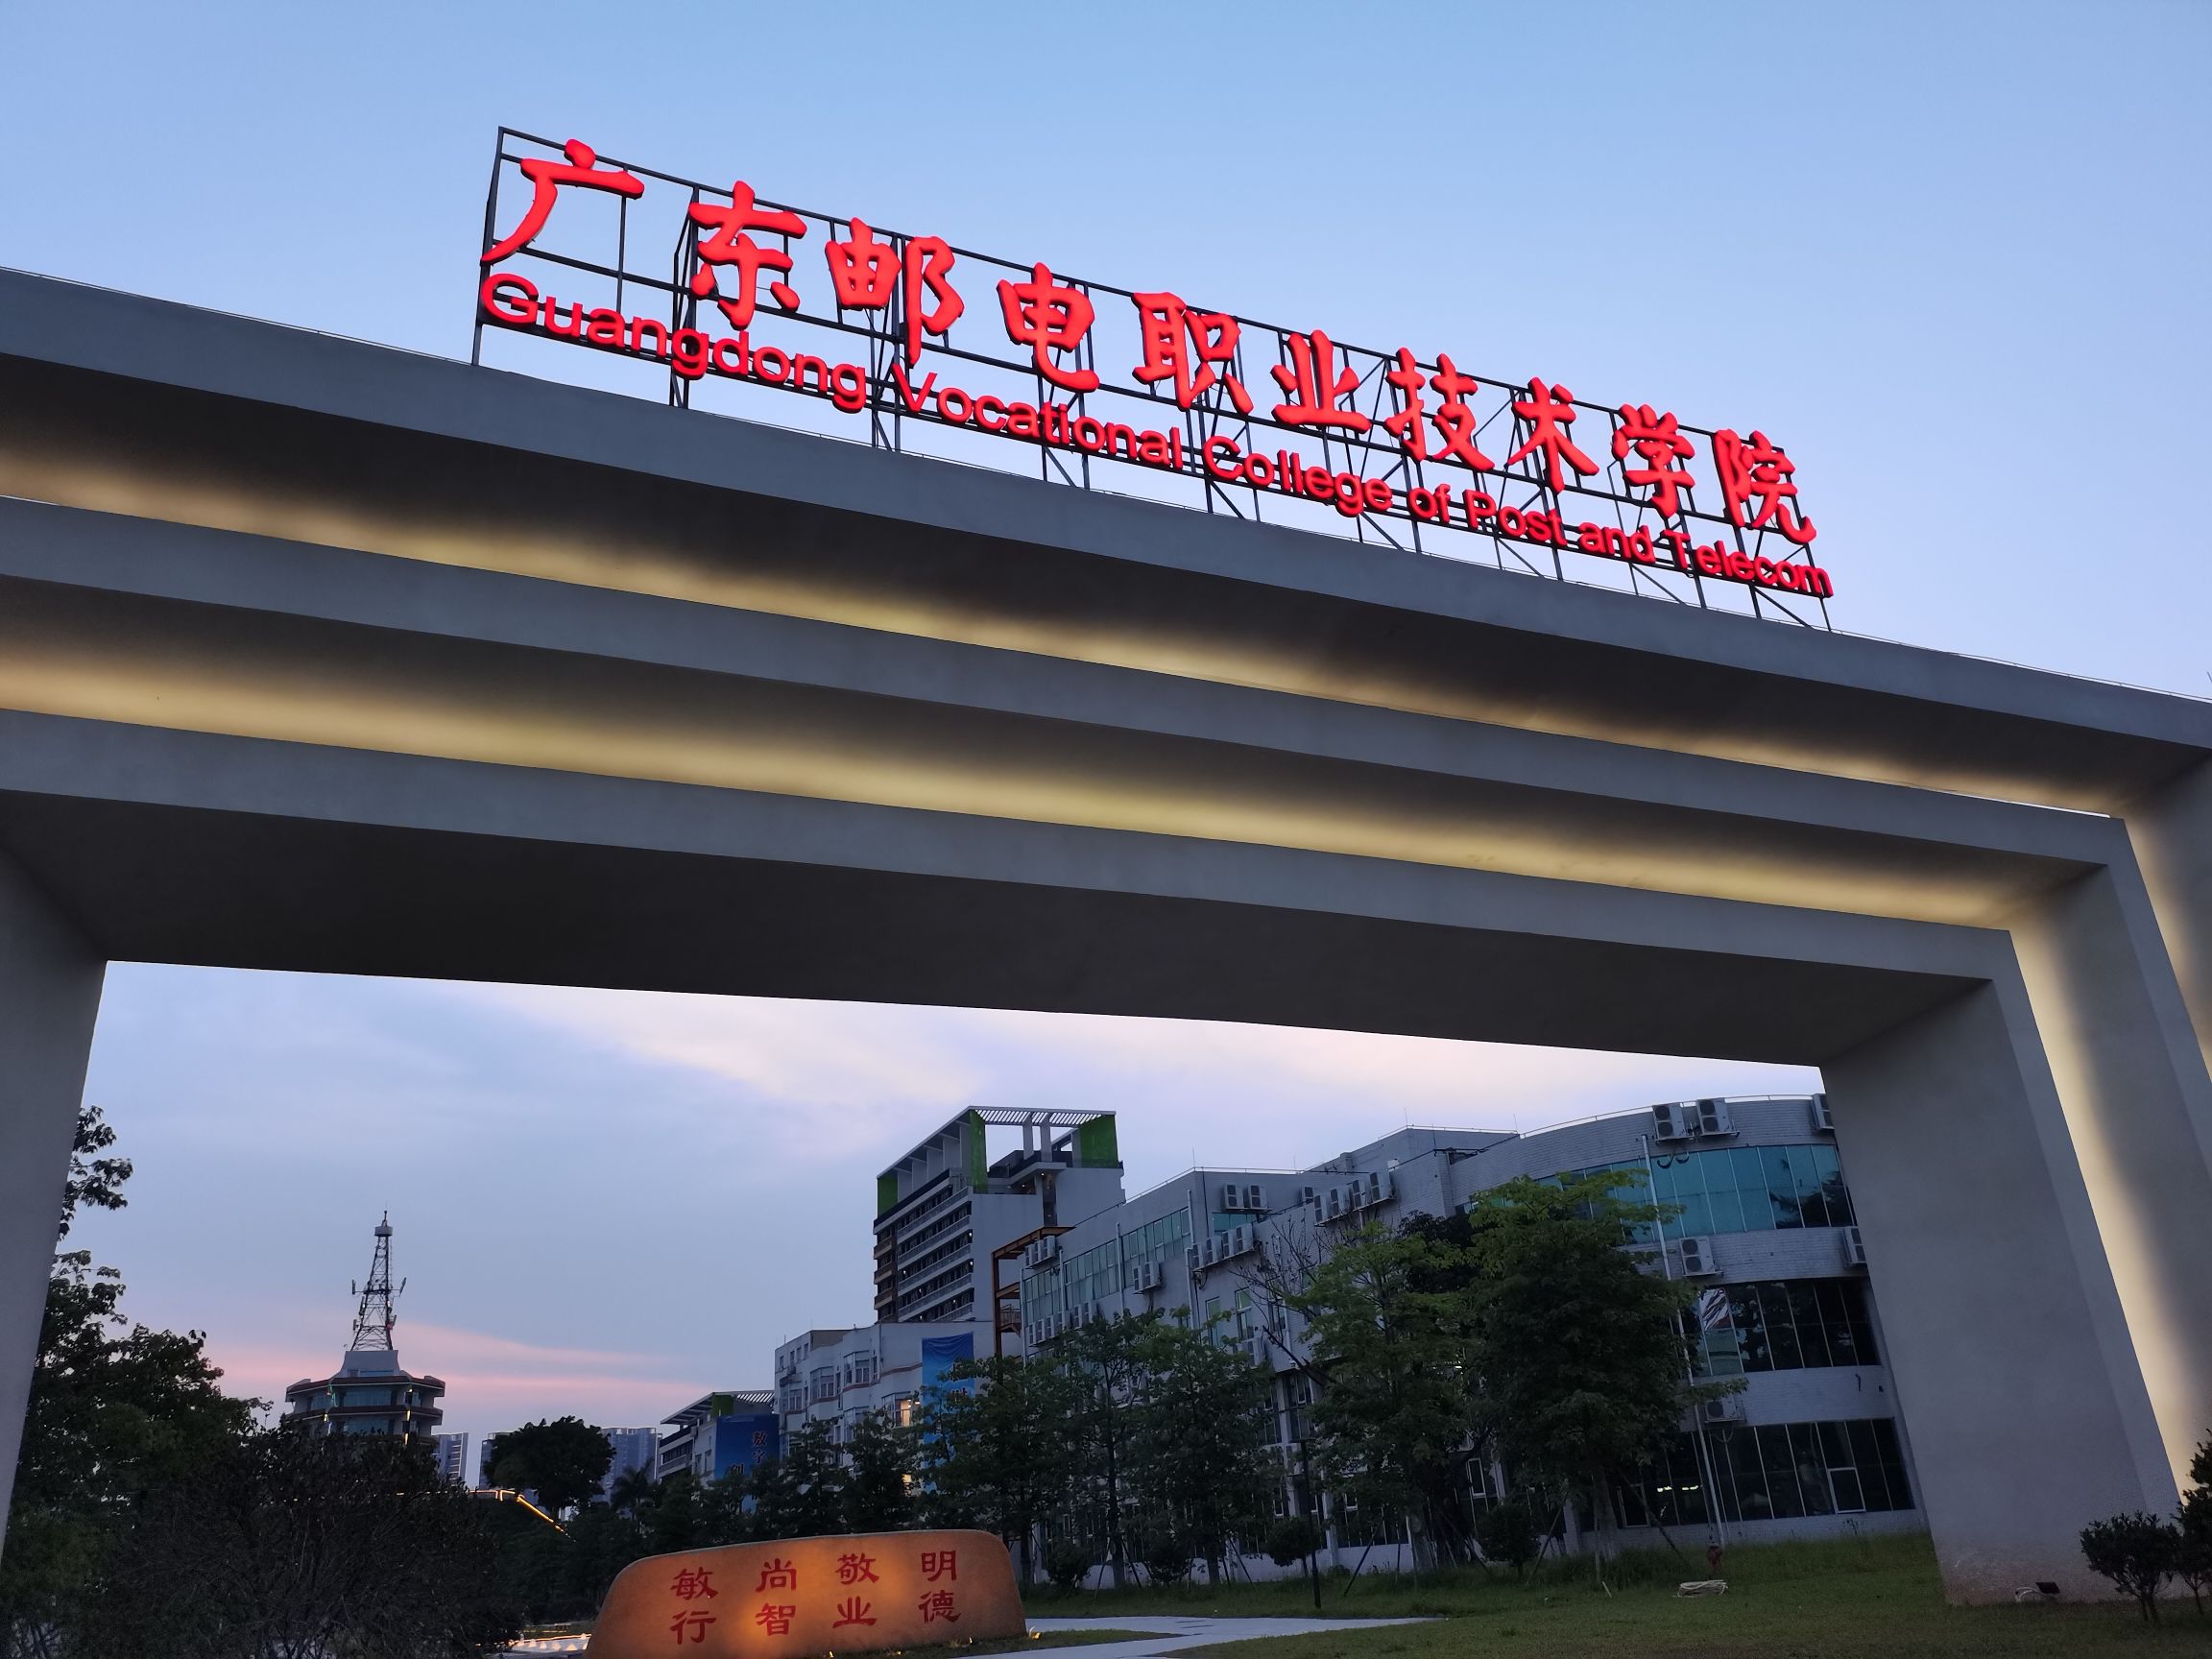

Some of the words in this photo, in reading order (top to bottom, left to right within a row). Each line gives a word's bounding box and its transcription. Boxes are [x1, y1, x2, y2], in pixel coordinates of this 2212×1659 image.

[480, 138, 1818, 544] 广东邮电职业技术学院
[480, 273, 867, 414] Guangdong
[891, 363, 1184, 470] Vocational
[1202, 435, 1394, 517] College
[1408, 483, 1451, 523] of
[1462, 488, 1568, 546] Post
[1577, 524, 1657, 564] and
[1659, 528, 1835, 597] Telecom
[669, 1566, 719, 1645] 敏行
[755, 1557, 797, 1636] 尚智
[832, 1552, 880, 1629] 敬业
[918, 1551, 961, 1624] 明德
